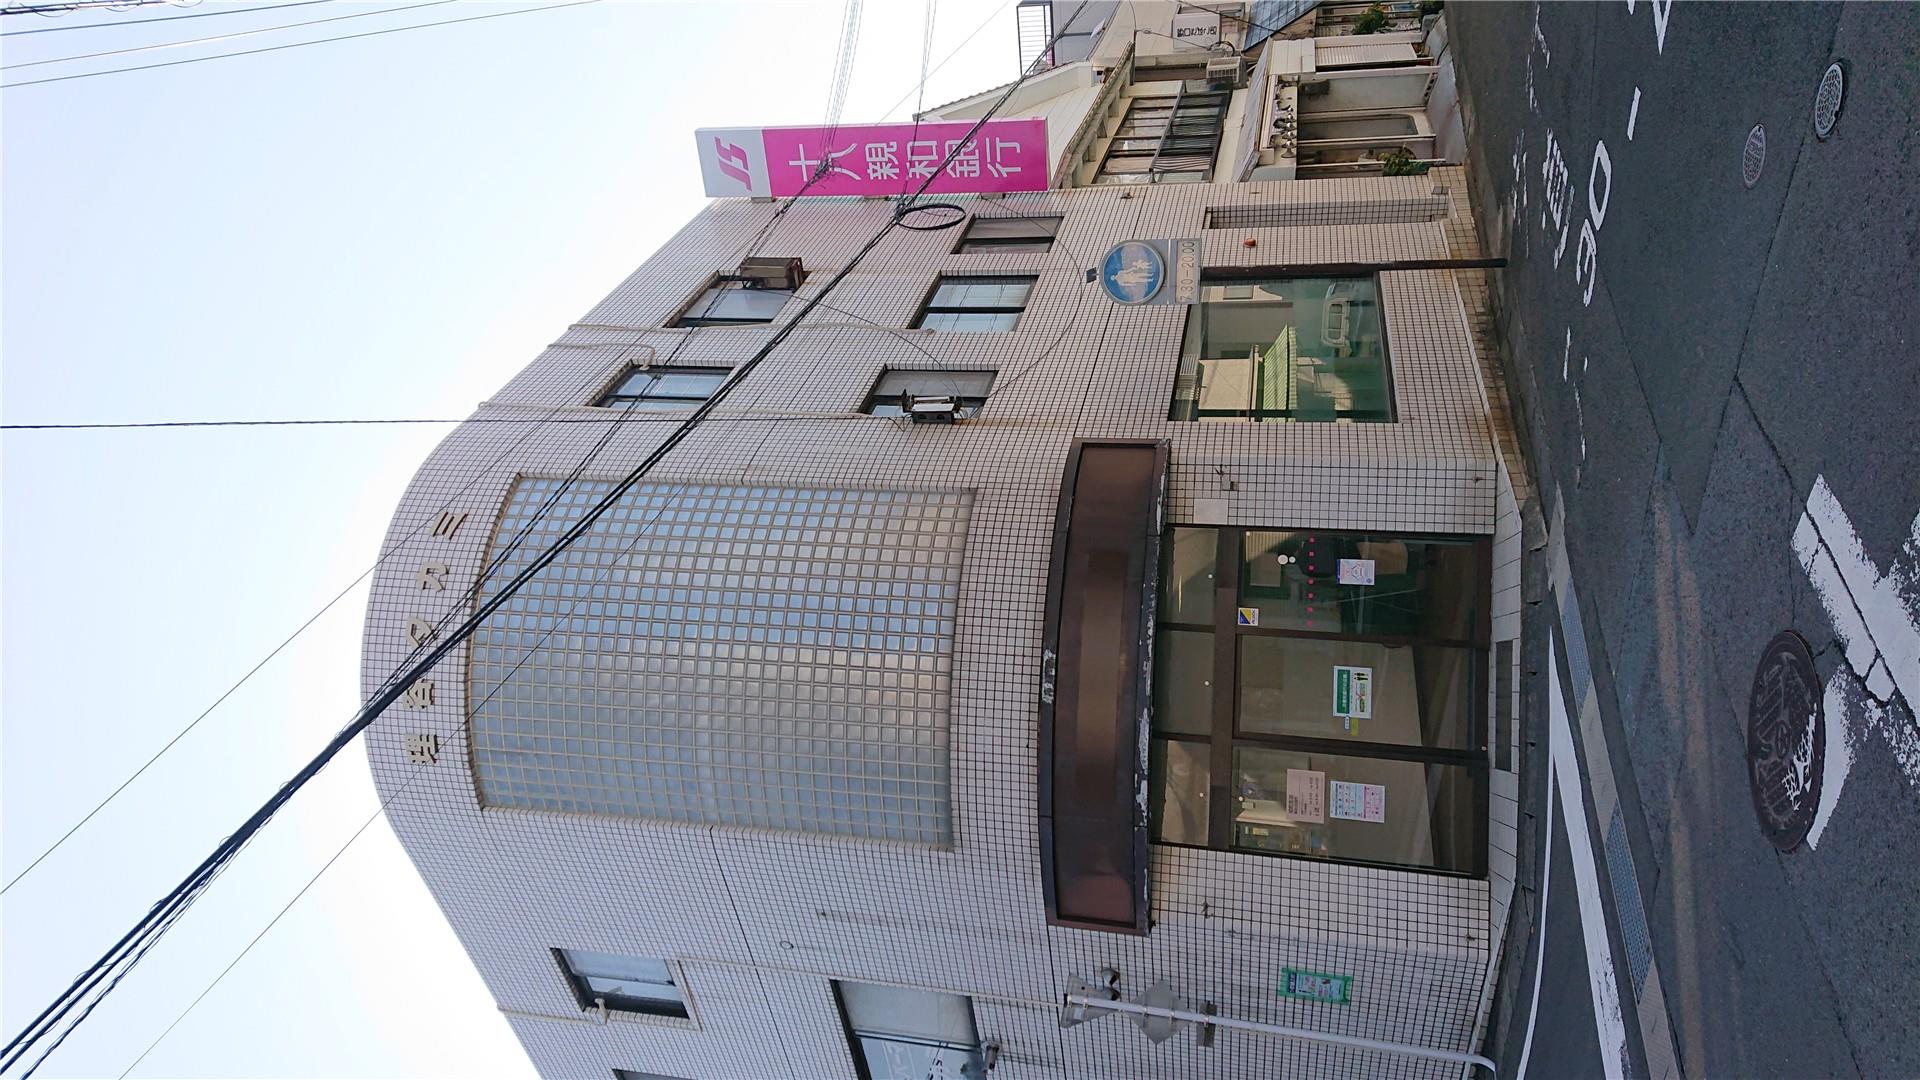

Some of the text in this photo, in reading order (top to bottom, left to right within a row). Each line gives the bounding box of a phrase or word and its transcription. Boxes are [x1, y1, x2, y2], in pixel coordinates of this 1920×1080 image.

[788, 137, 1022, 182] 十八親和銀行
[1575, 139, 1612, 307] 30
